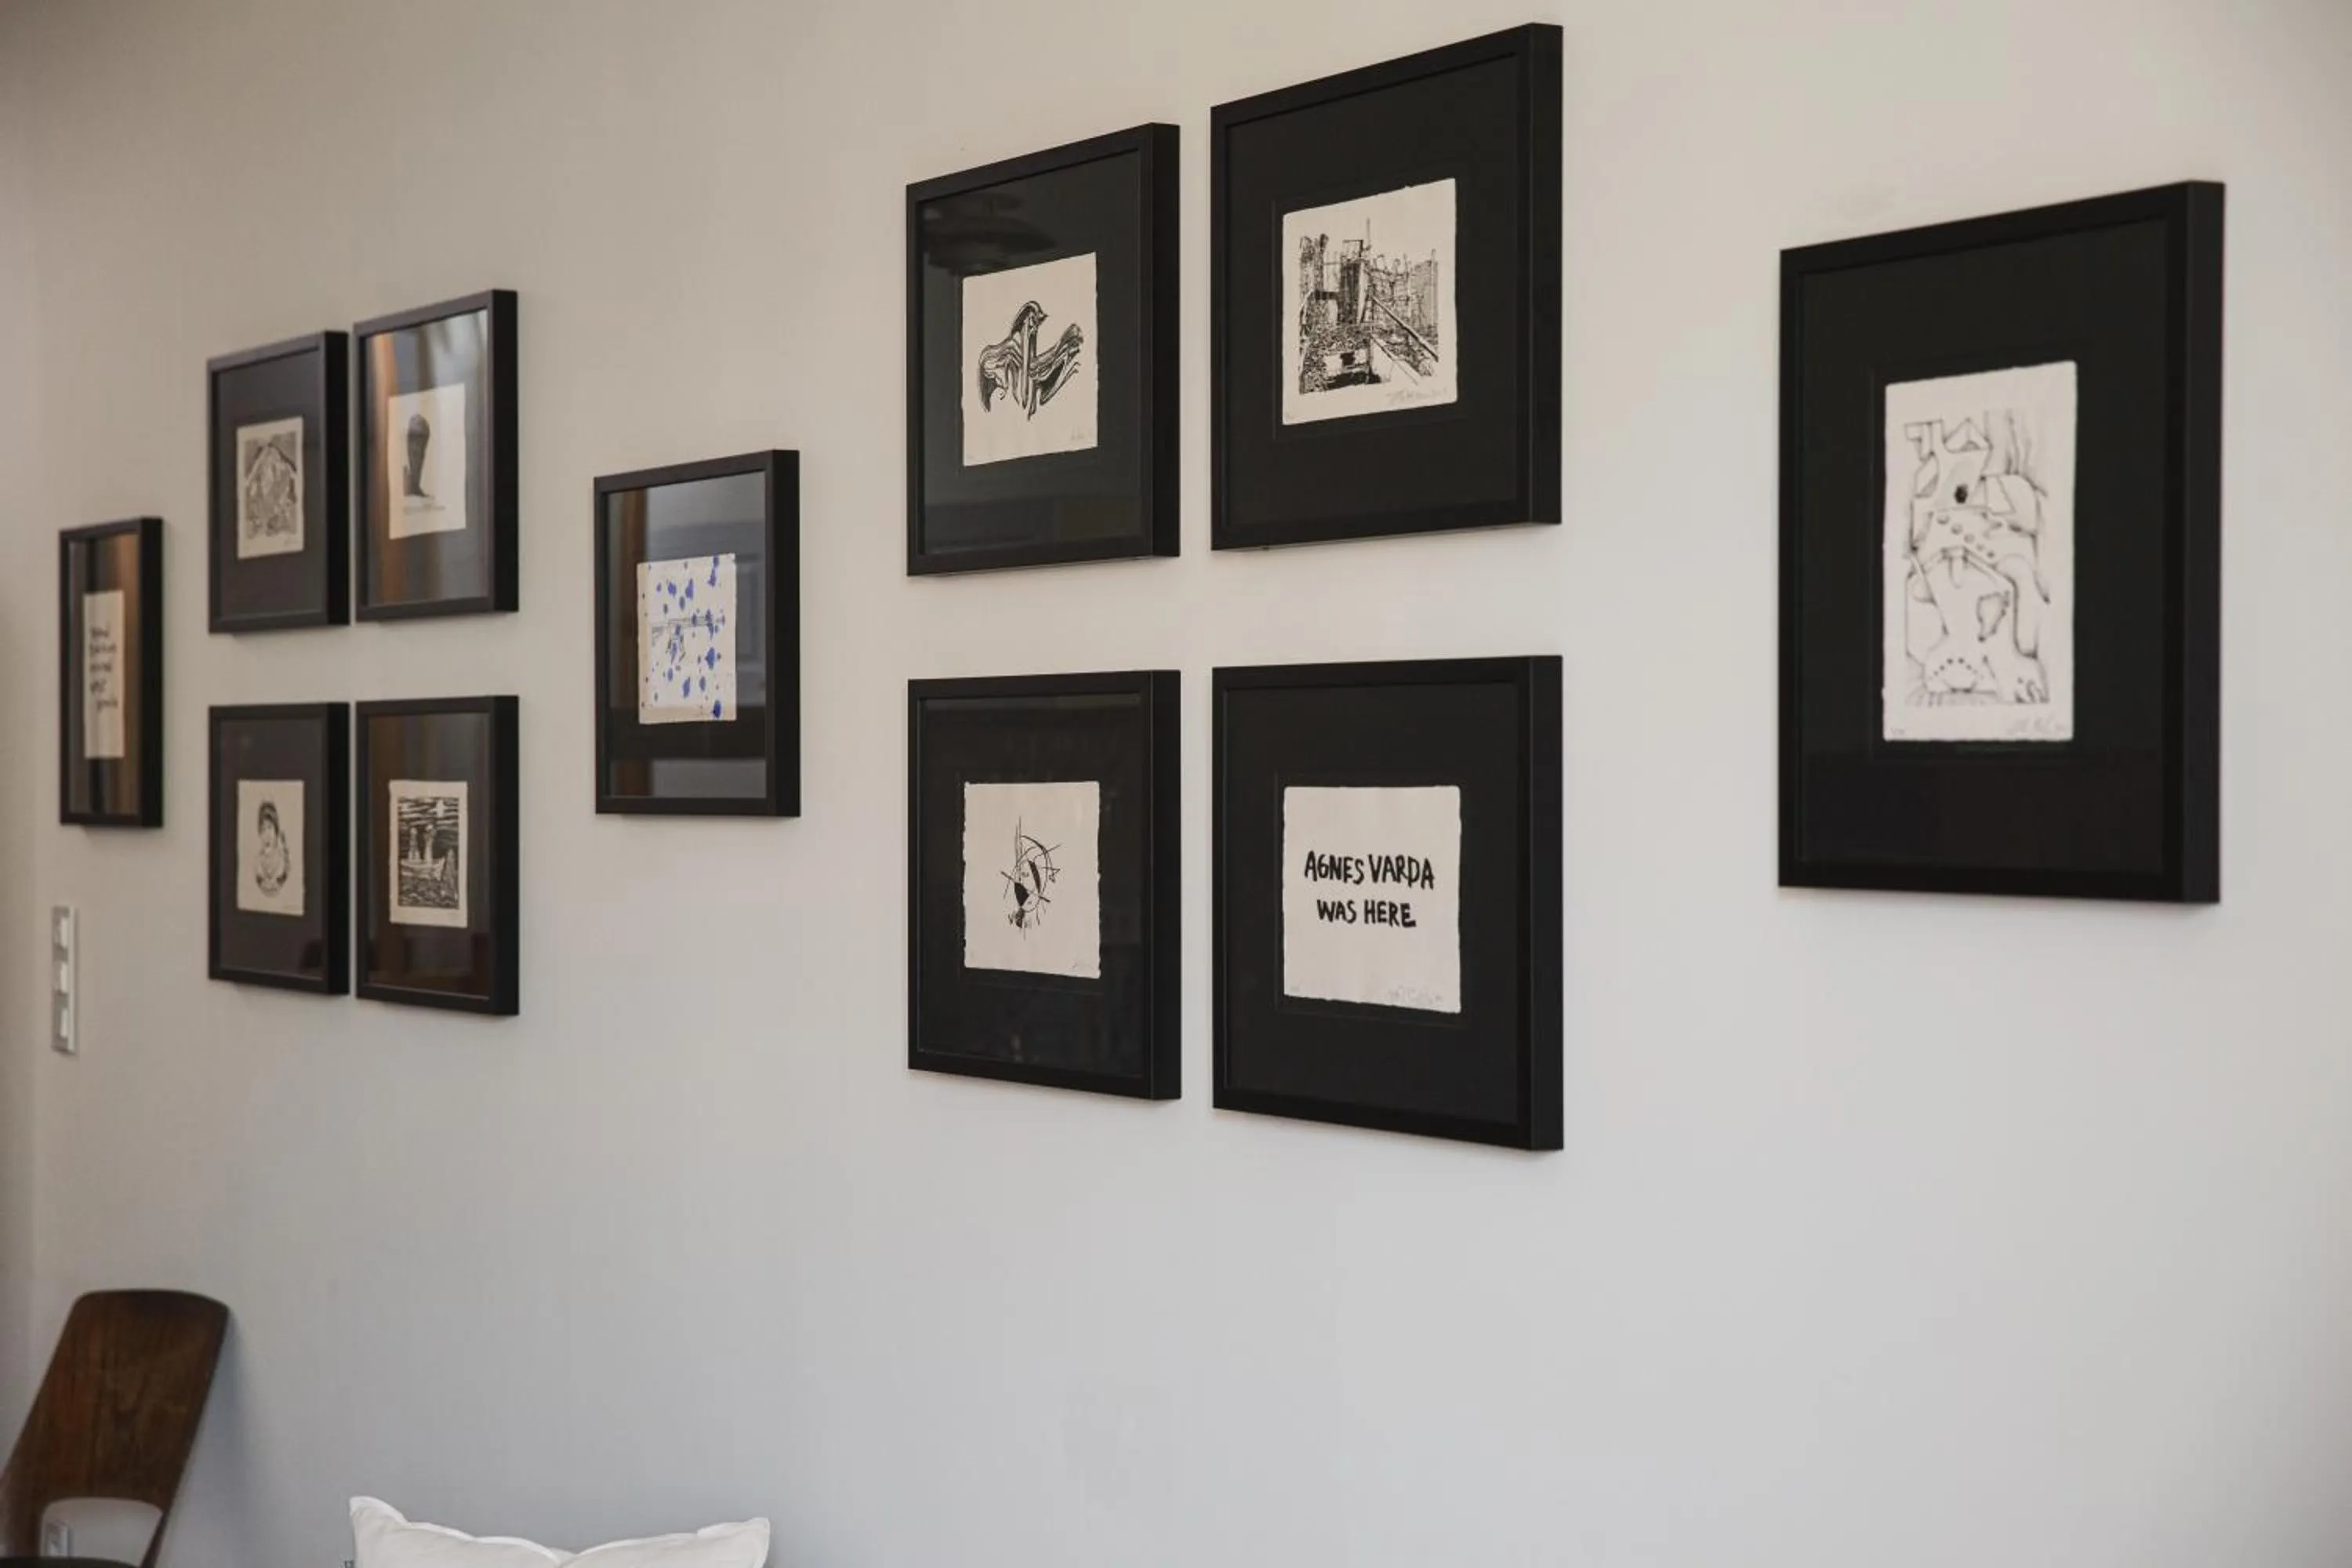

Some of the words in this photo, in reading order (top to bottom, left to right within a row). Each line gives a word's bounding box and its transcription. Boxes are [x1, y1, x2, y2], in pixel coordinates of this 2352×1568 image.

[1304, 850, 1364, 885] AGNES
[1367, 853, 1435, 890] VARDA
[1316, 899, 1356, 924] WAS
[1363, 899, 1417, 927] HERE
